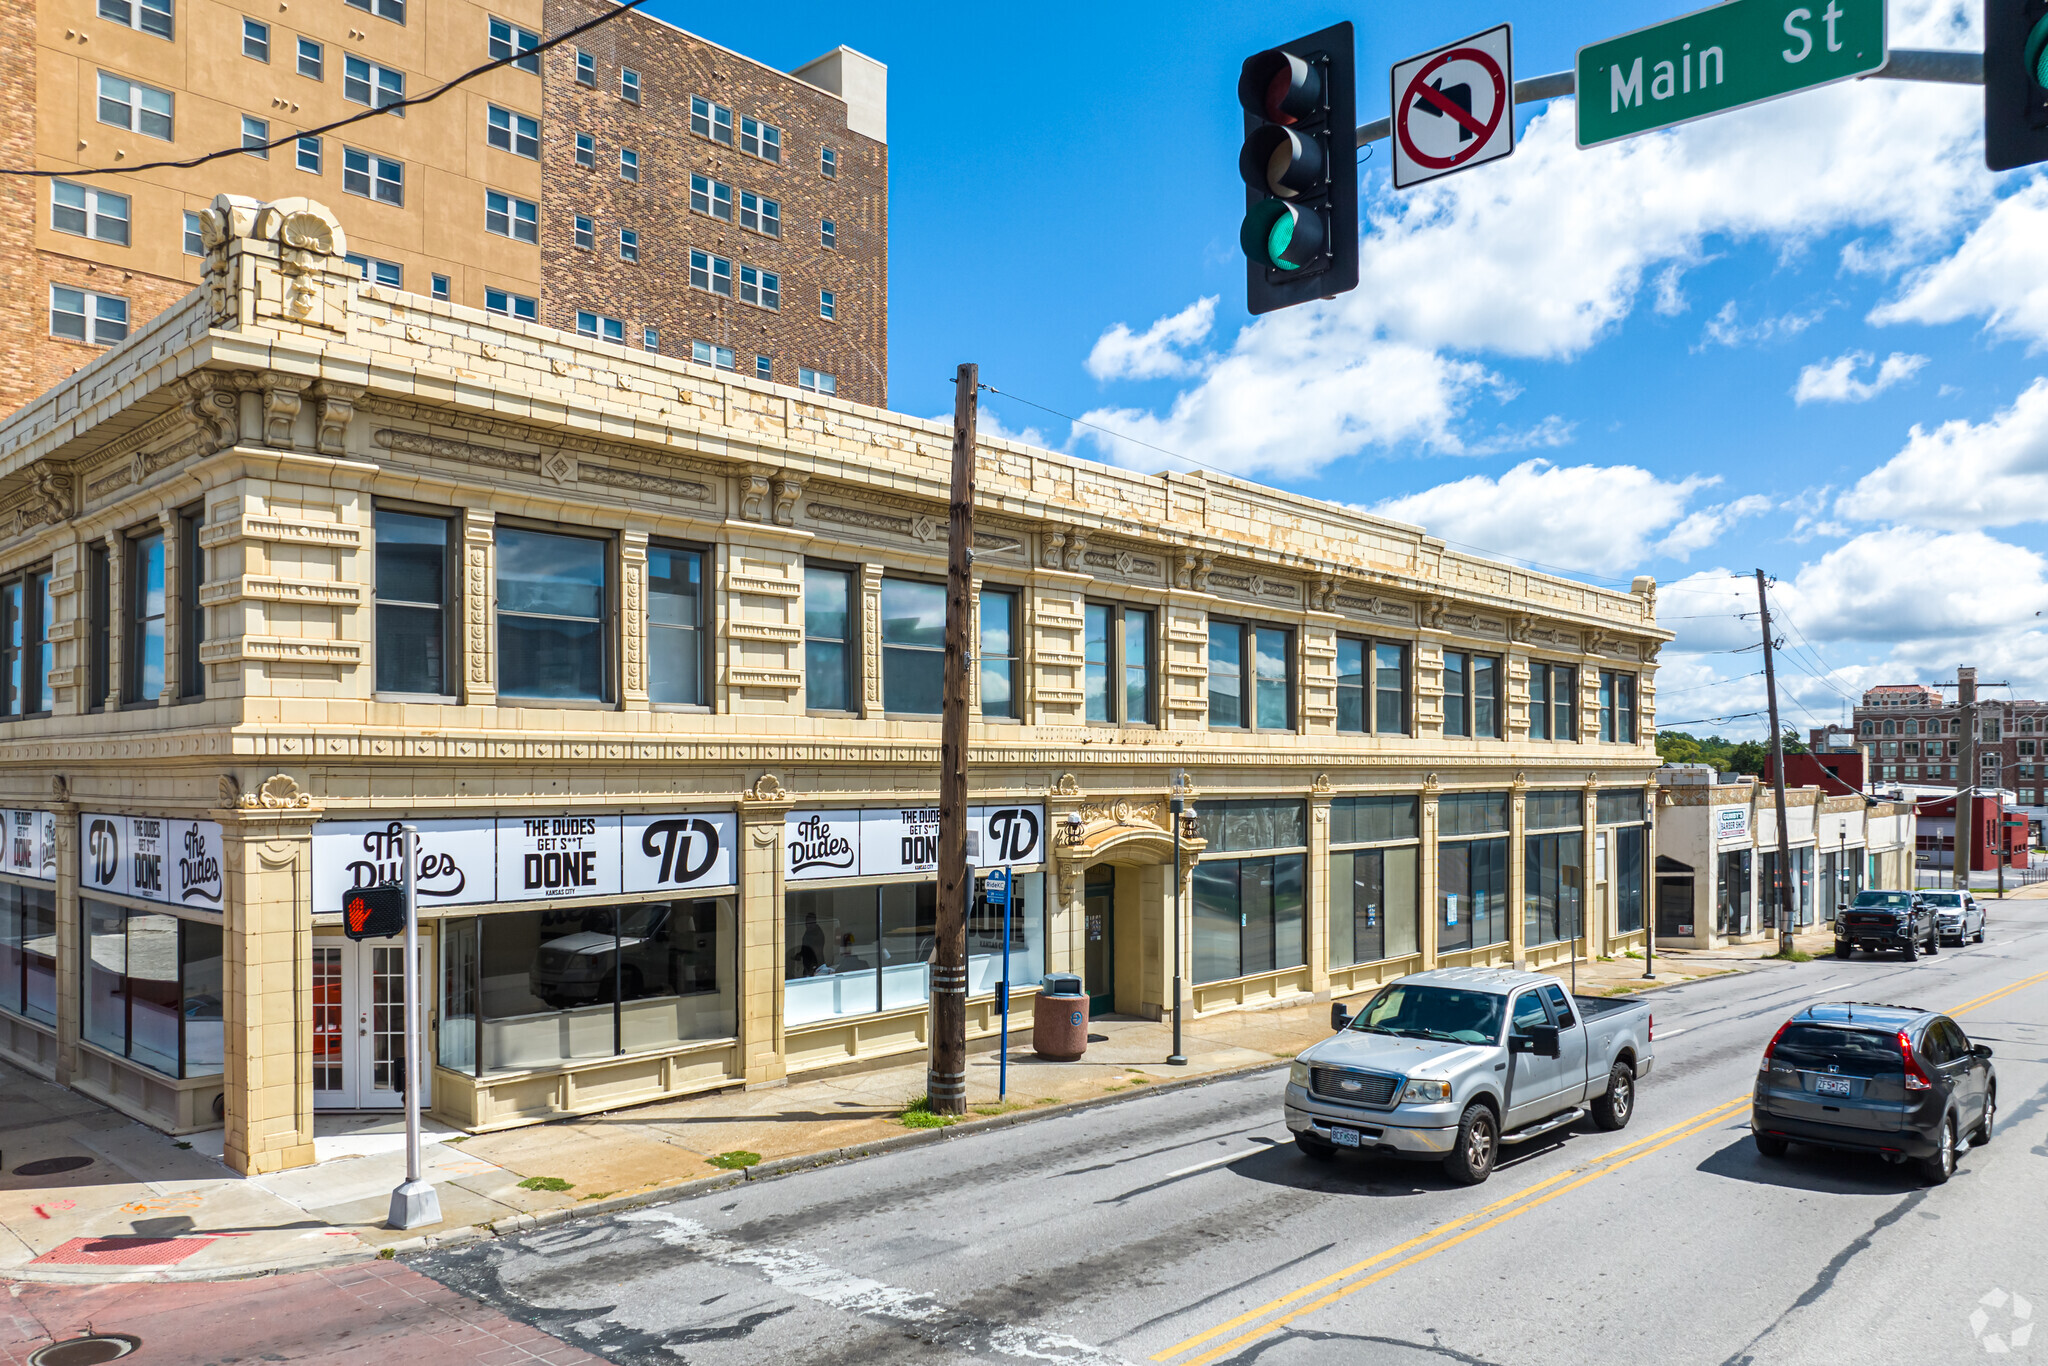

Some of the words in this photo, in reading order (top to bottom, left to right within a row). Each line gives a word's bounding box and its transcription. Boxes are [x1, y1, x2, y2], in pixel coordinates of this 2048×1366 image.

[1611, 43, 1724, 114] Main
[1782, 0, 1845, 64] St
[134, 820, 143, 836] THE
[144, 820, 160, 838] DUDES
[524, 819, 549, 837] THE
[553, 818, 596, 836] DUDES
[798, 815, 831, 843] The
[901, 811, 917, 824] THE
[910, 825, 922, 835] GET
[184, 822, 206, 859] The
[537, 838, 557, 851] GET
[788, 838, 852, 866] Dudes
[902, 836, 939, 866] DON
[134, 853, 161, 892] DONE
[179, 853, 221, 890] Dudes
[524, 851, 597, 889] DONE
